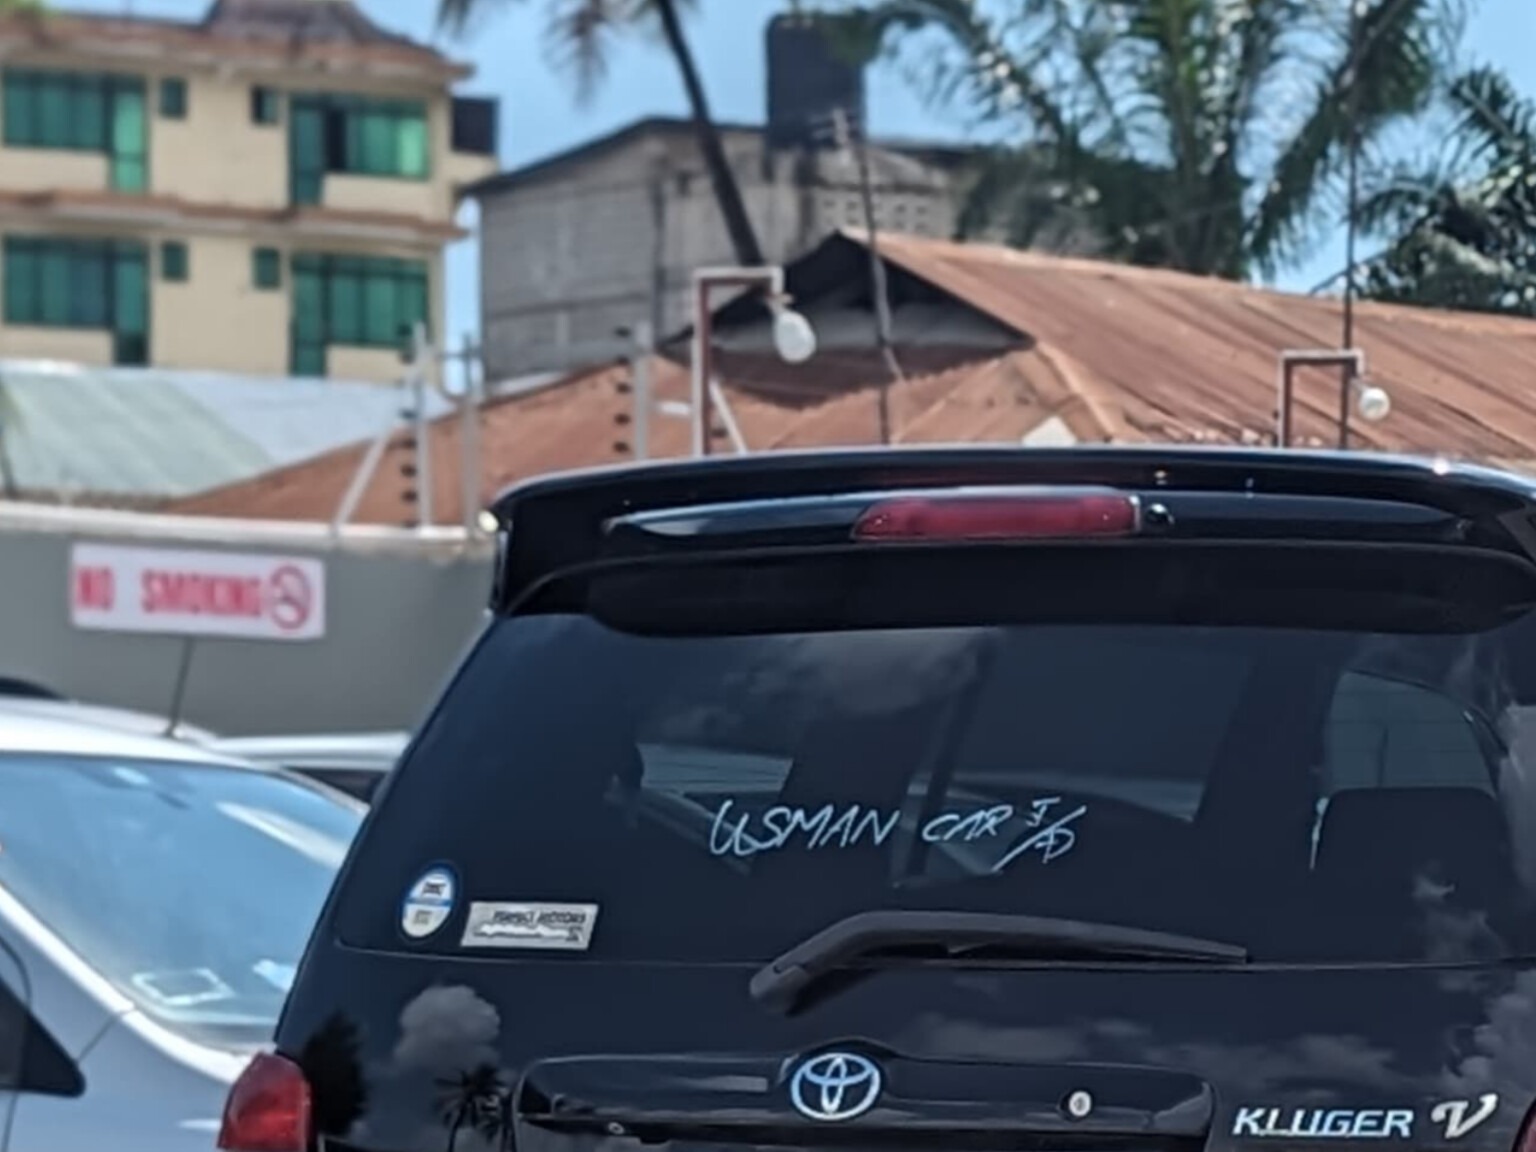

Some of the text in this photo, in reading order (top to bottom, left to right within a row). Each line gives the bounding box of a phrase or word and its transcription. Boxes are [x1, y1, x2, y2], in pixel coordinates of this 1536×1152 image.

[709, 800, 900, 855] USMAN
[921, 804, 1013, 842] CAR
[1231, 1093, 1498, 1140] KLUGER V
